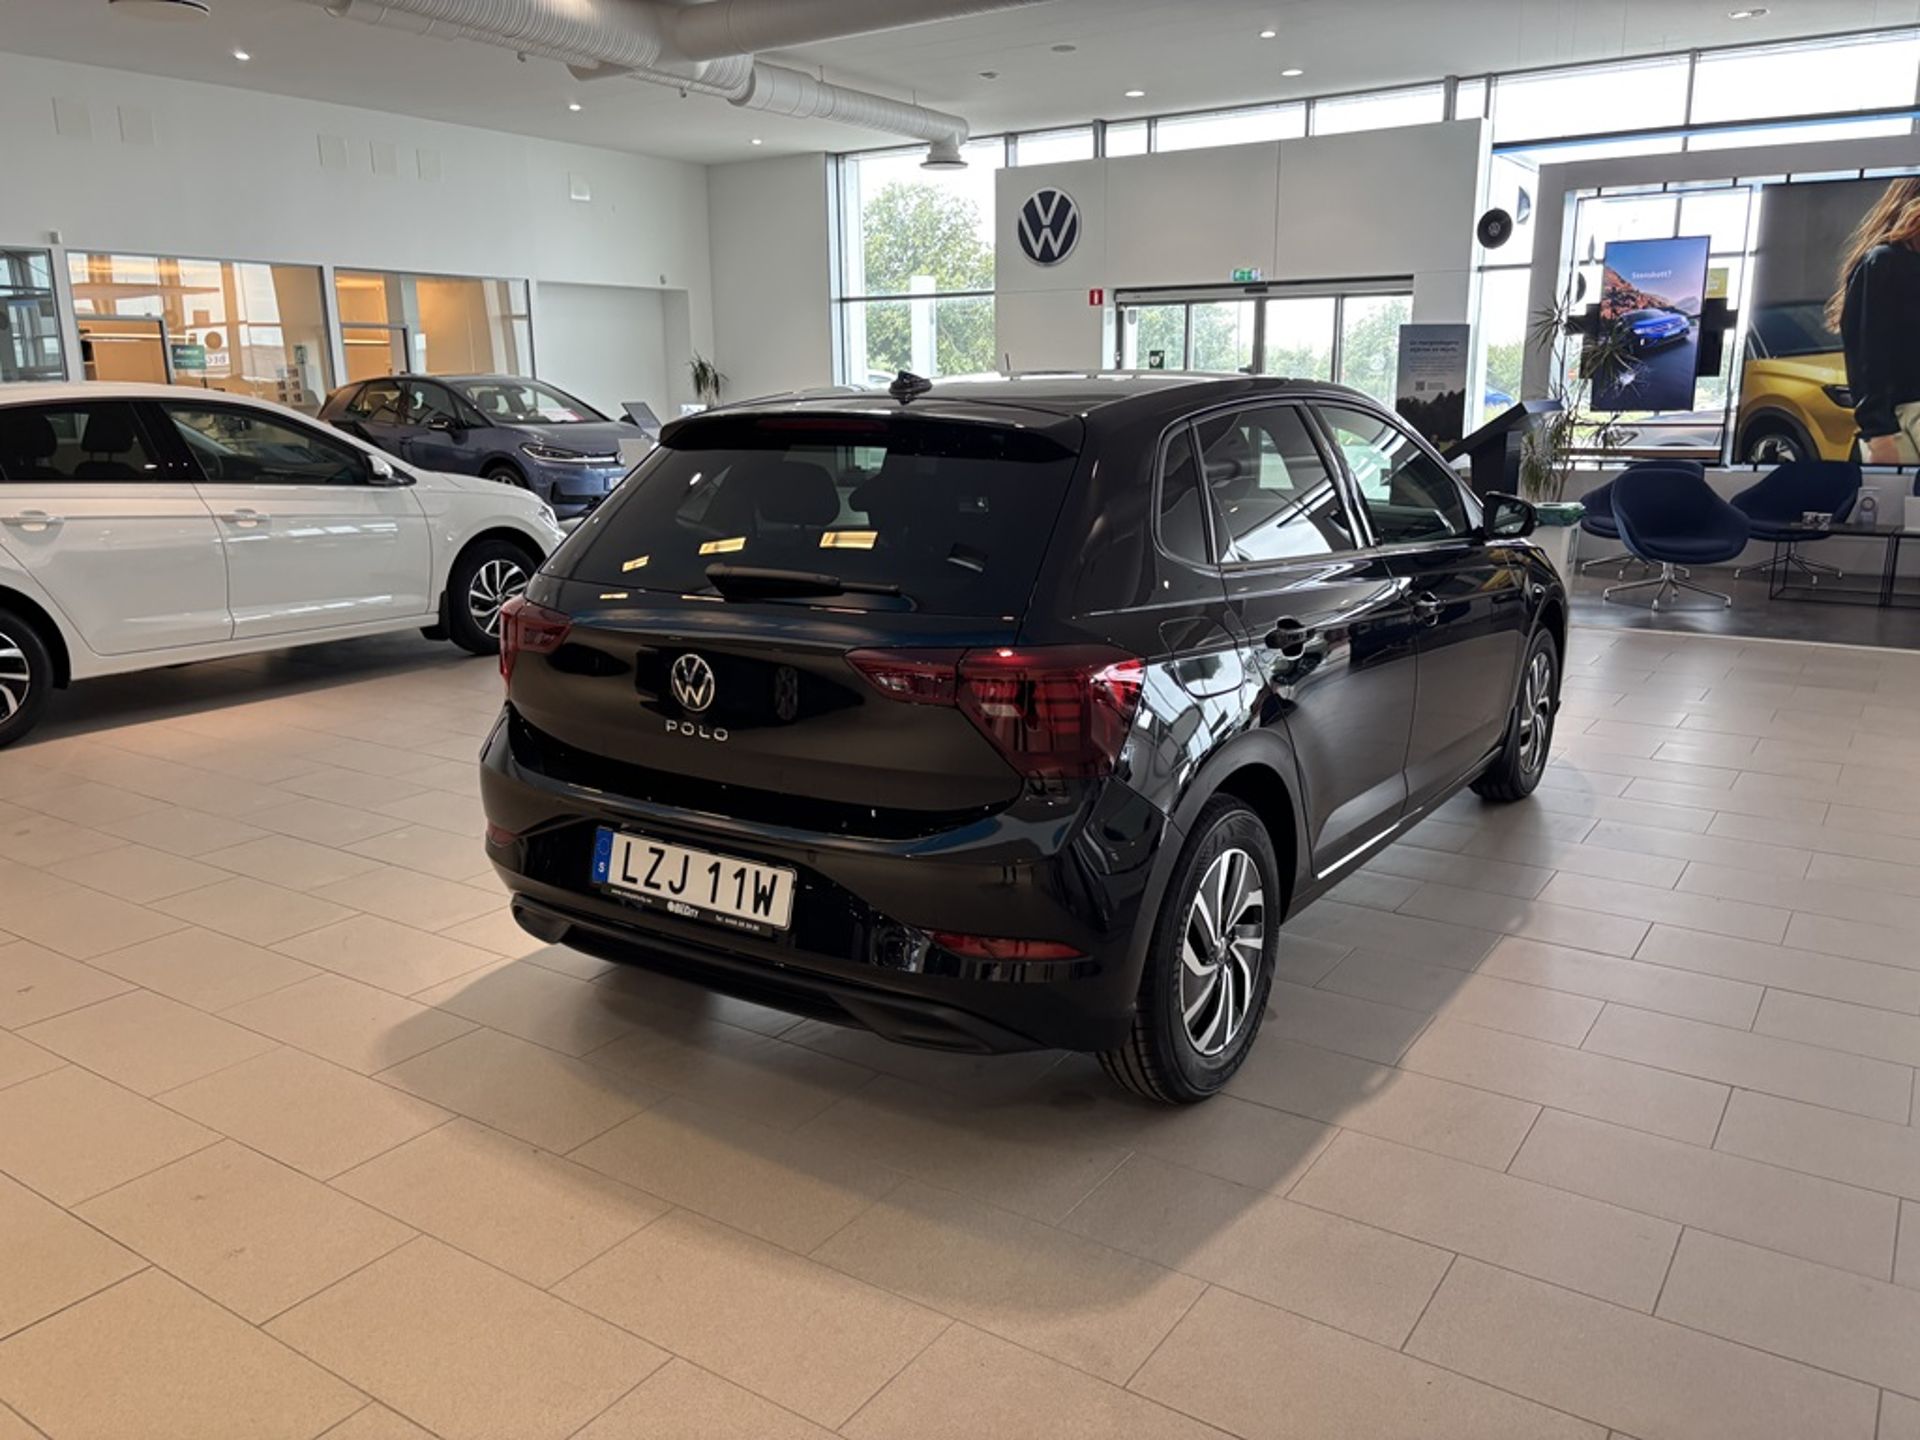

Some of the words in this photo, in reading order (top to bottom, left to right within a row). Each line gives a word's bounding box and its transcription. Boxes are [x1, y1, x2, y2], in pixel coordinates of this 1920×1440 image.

[1018, 188, 1078, 263] VW
[671, 654, 715, 711] VW
[665, 719, 729, 741] POLO
[621, 841, 690, 895] LZJ
[707, 861, 778, 917] 11W
